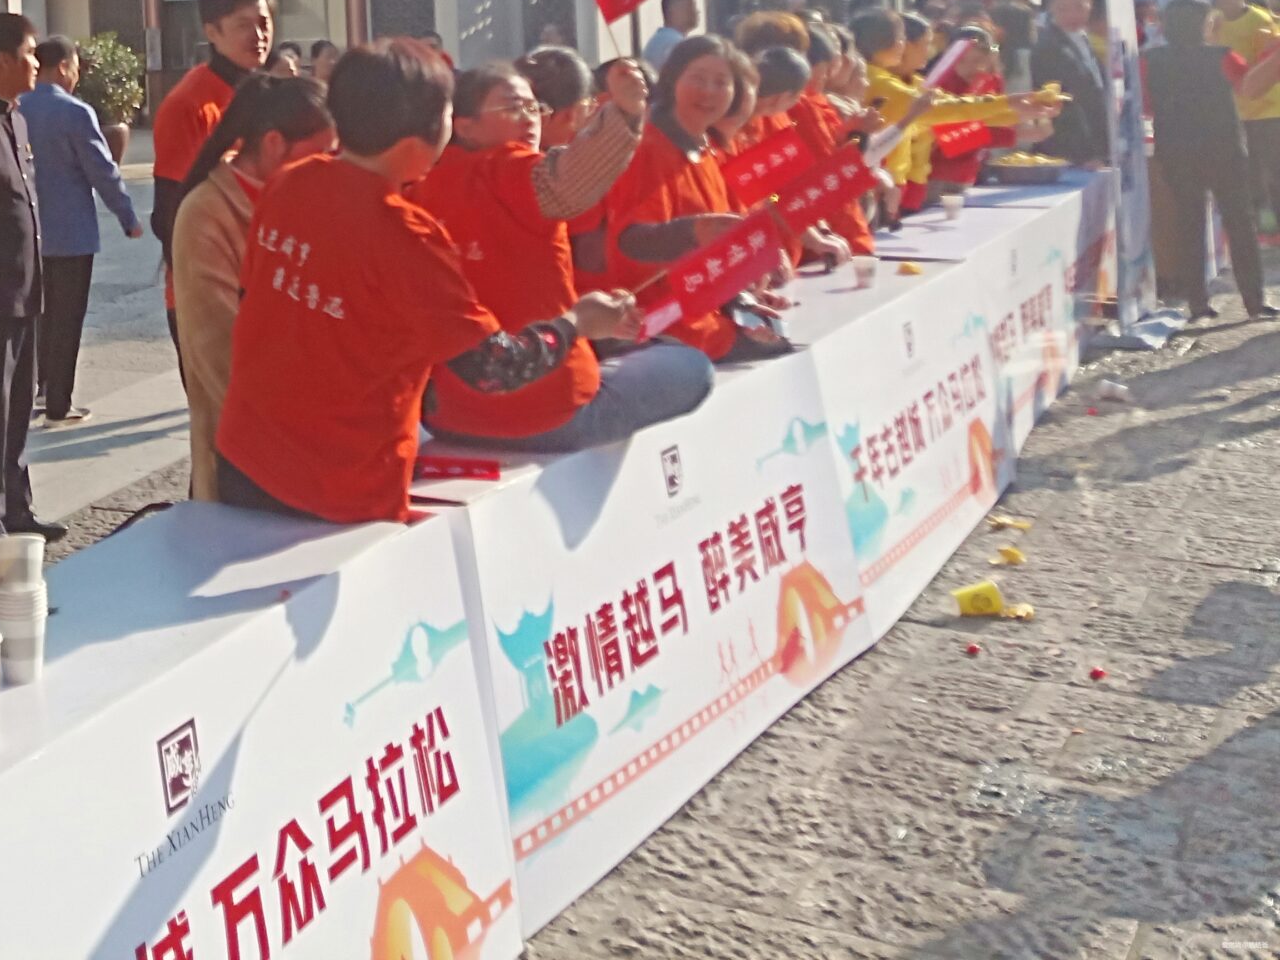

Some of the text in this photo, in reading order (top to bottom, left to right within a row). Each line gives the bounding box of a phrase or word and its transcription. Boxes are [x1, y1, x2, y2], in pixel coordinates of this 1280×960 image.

[543, 483, 807, 730] 激情越马 醉美咸亨
[211, 705, 461, 960] 万众马拉松
